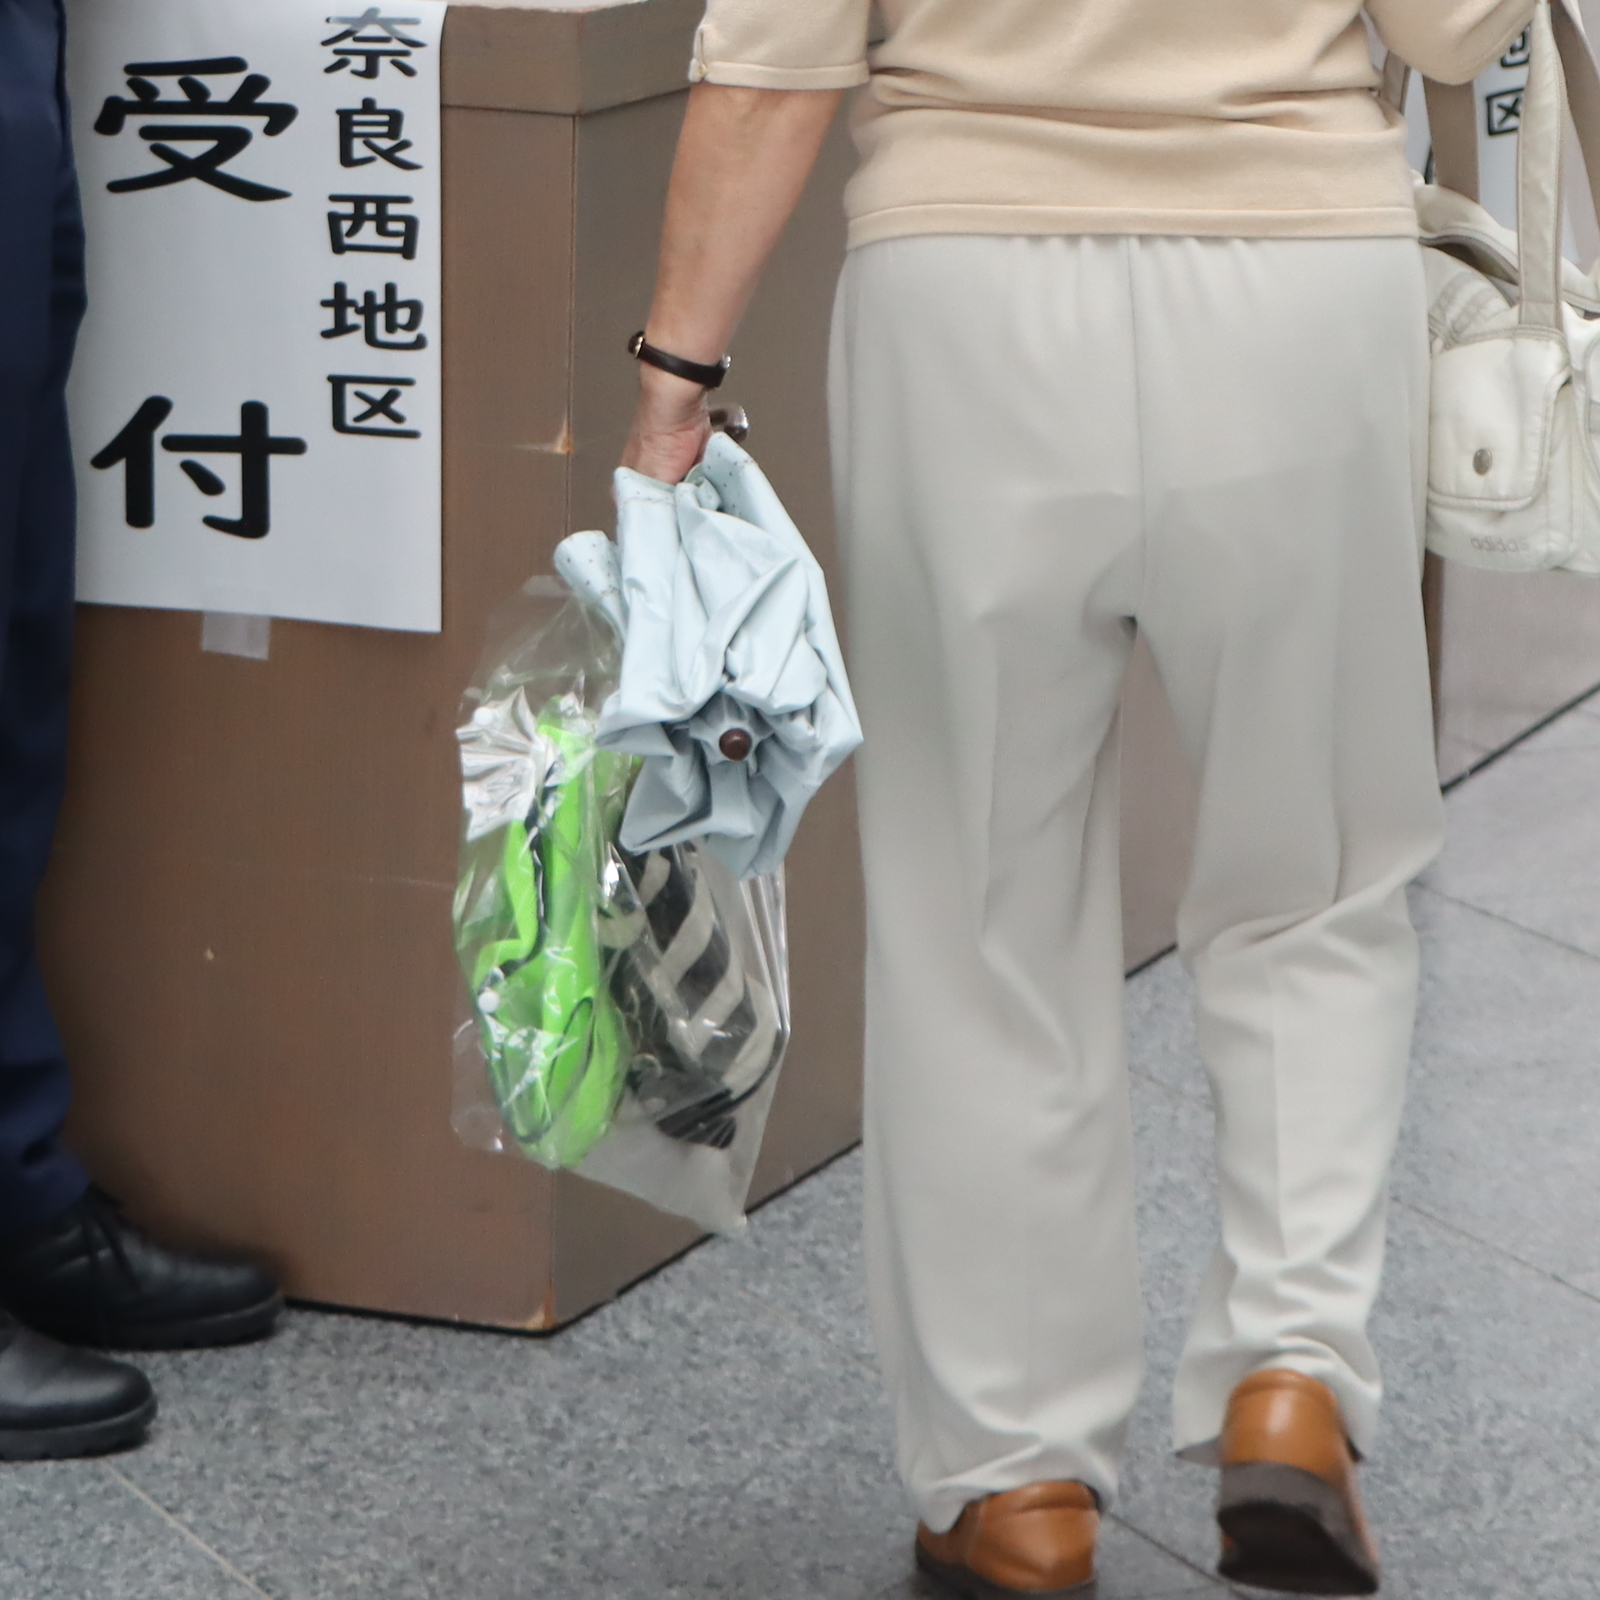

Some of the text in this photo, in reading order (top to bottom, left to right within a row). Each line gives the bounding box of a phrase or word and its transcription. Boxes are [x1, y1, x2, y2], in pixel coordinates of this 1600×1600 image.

[90, 56, 308, 540] 受付
[320, 7, 428, 439] 奈良西地区
